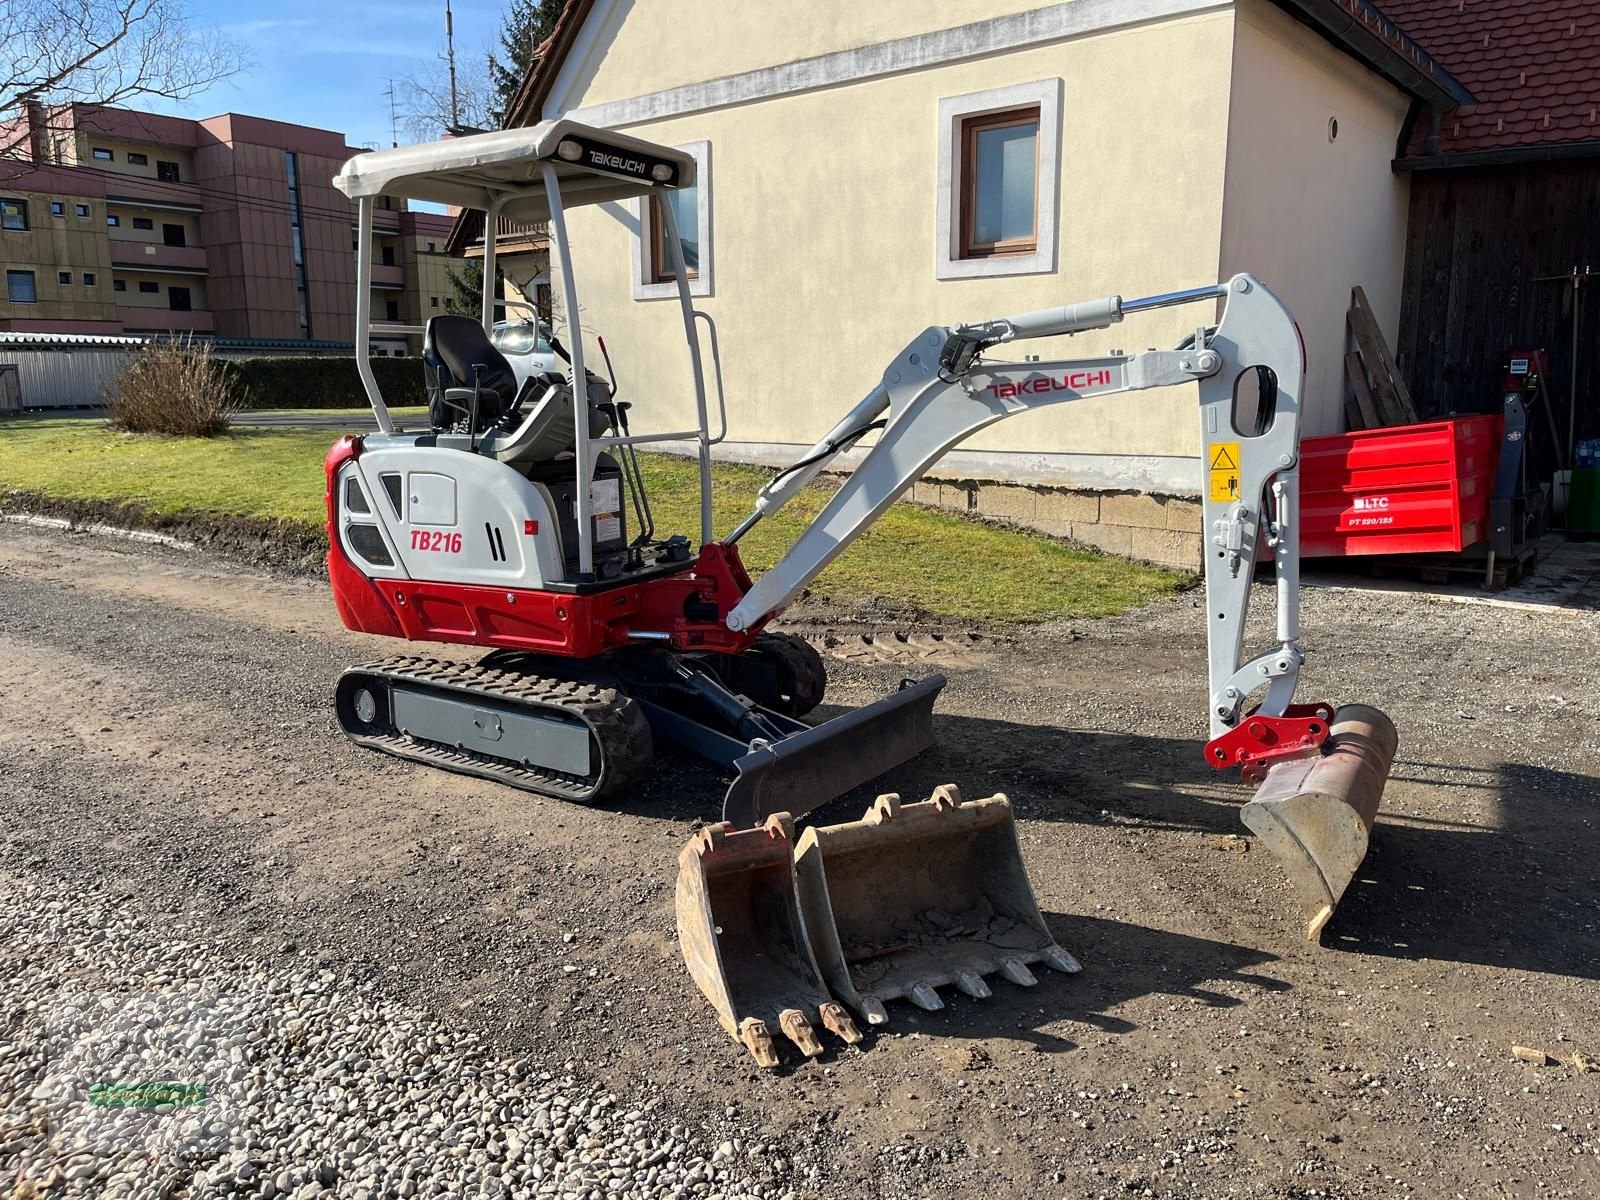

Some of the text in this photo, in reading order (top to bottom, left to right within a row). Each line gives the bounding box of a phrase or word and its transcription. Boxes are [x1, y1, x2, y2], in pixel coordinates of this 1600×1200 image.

[589, 150, 646, 174] TAKEUCHI
[986, 370, 1111, 398] TAKEUCHI
[1365, 497, 1389, 509] LTC
[1348, 518, 1361, 526] PT
[410, 530, 462, 553] TB216
